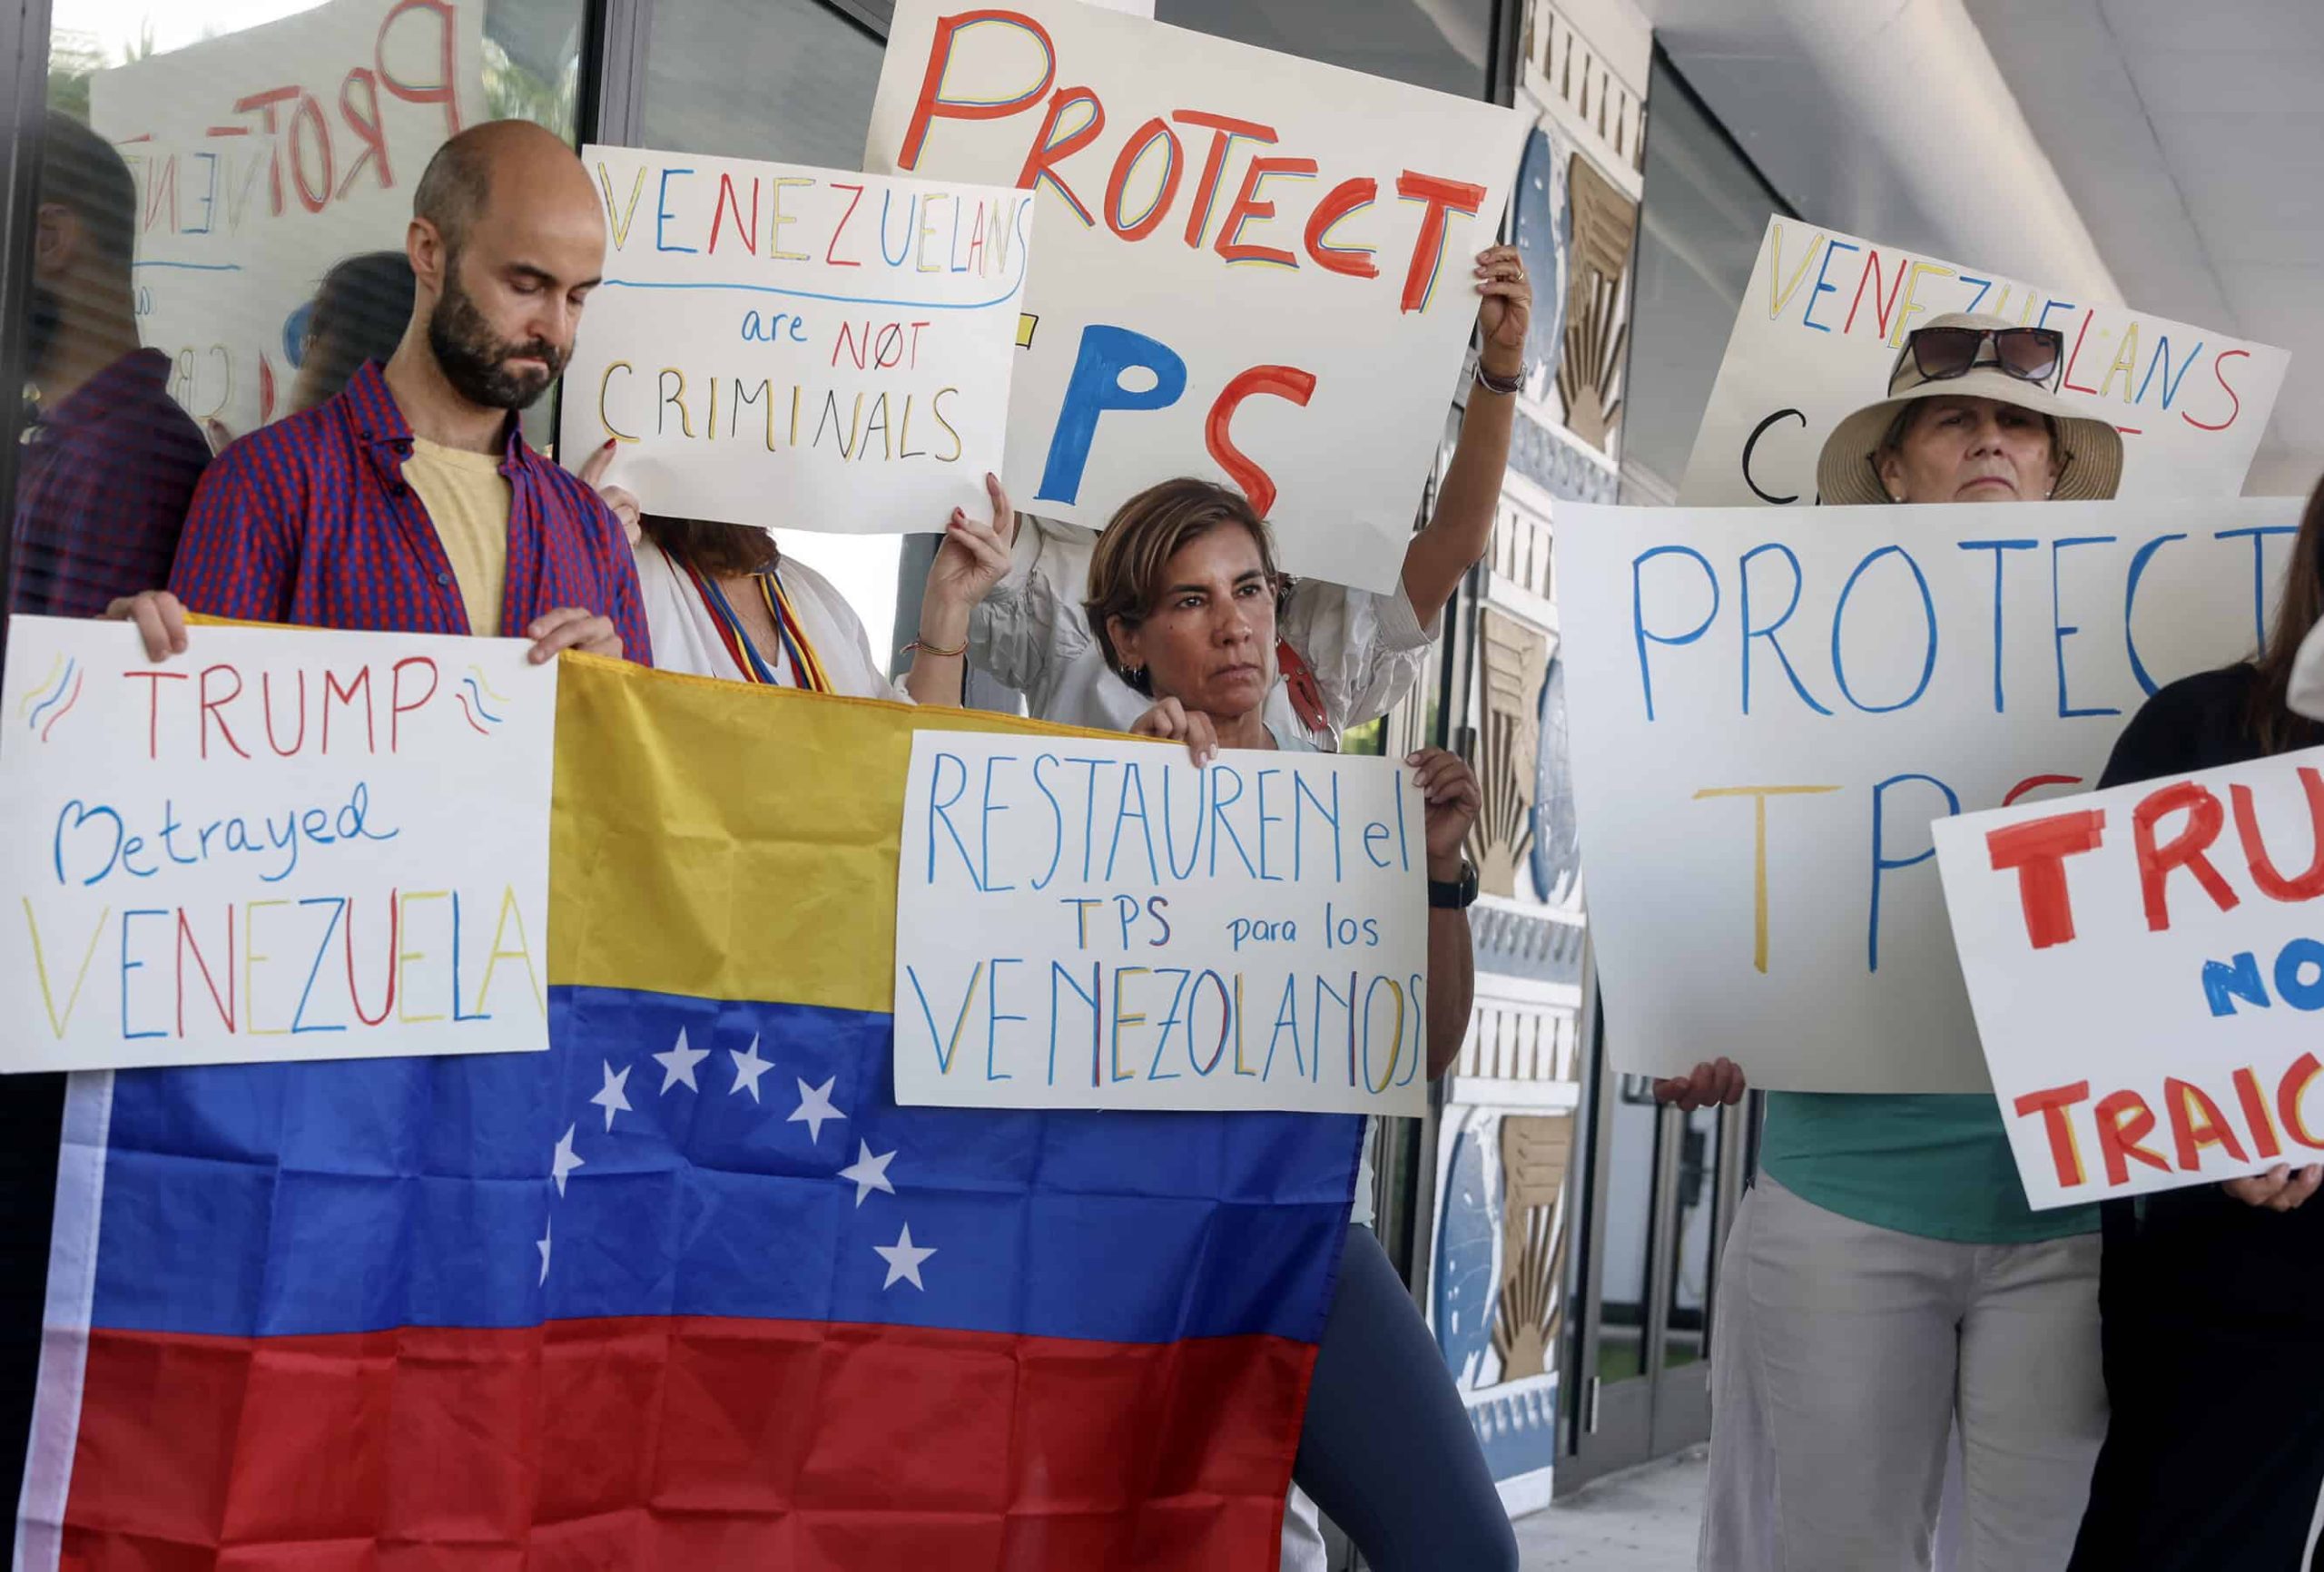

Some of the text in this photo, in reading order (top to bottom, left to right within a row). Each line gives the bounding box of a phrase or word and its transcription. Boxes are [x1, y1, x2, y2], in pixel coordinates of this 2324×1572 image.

[597, 161, 1031, 280] VENEZUELANS
[897, 8, 1488, 315] PROTECT
[740, 309, 809, 342] are
[598, 359, 962, 462] CRIMINALS
[1016, 313, 1316, 519] PS
[1633, 526, 2300, 722] PROTECT
[123, 656, 438, 760] TRUMP
[54, 781, 399, 886] Betrayed
[927, 752, 1410, 892] RESTAUREN el
[1691, 773, 2083, 974] TP
[22, 884, 547, 1040] VENEZUELA
[1060, 894, 1379, 952] TPS para los
[2201, 938, 2324, 1017] NO
[906, 958, 1423, 1095] VENEZOLANOS
